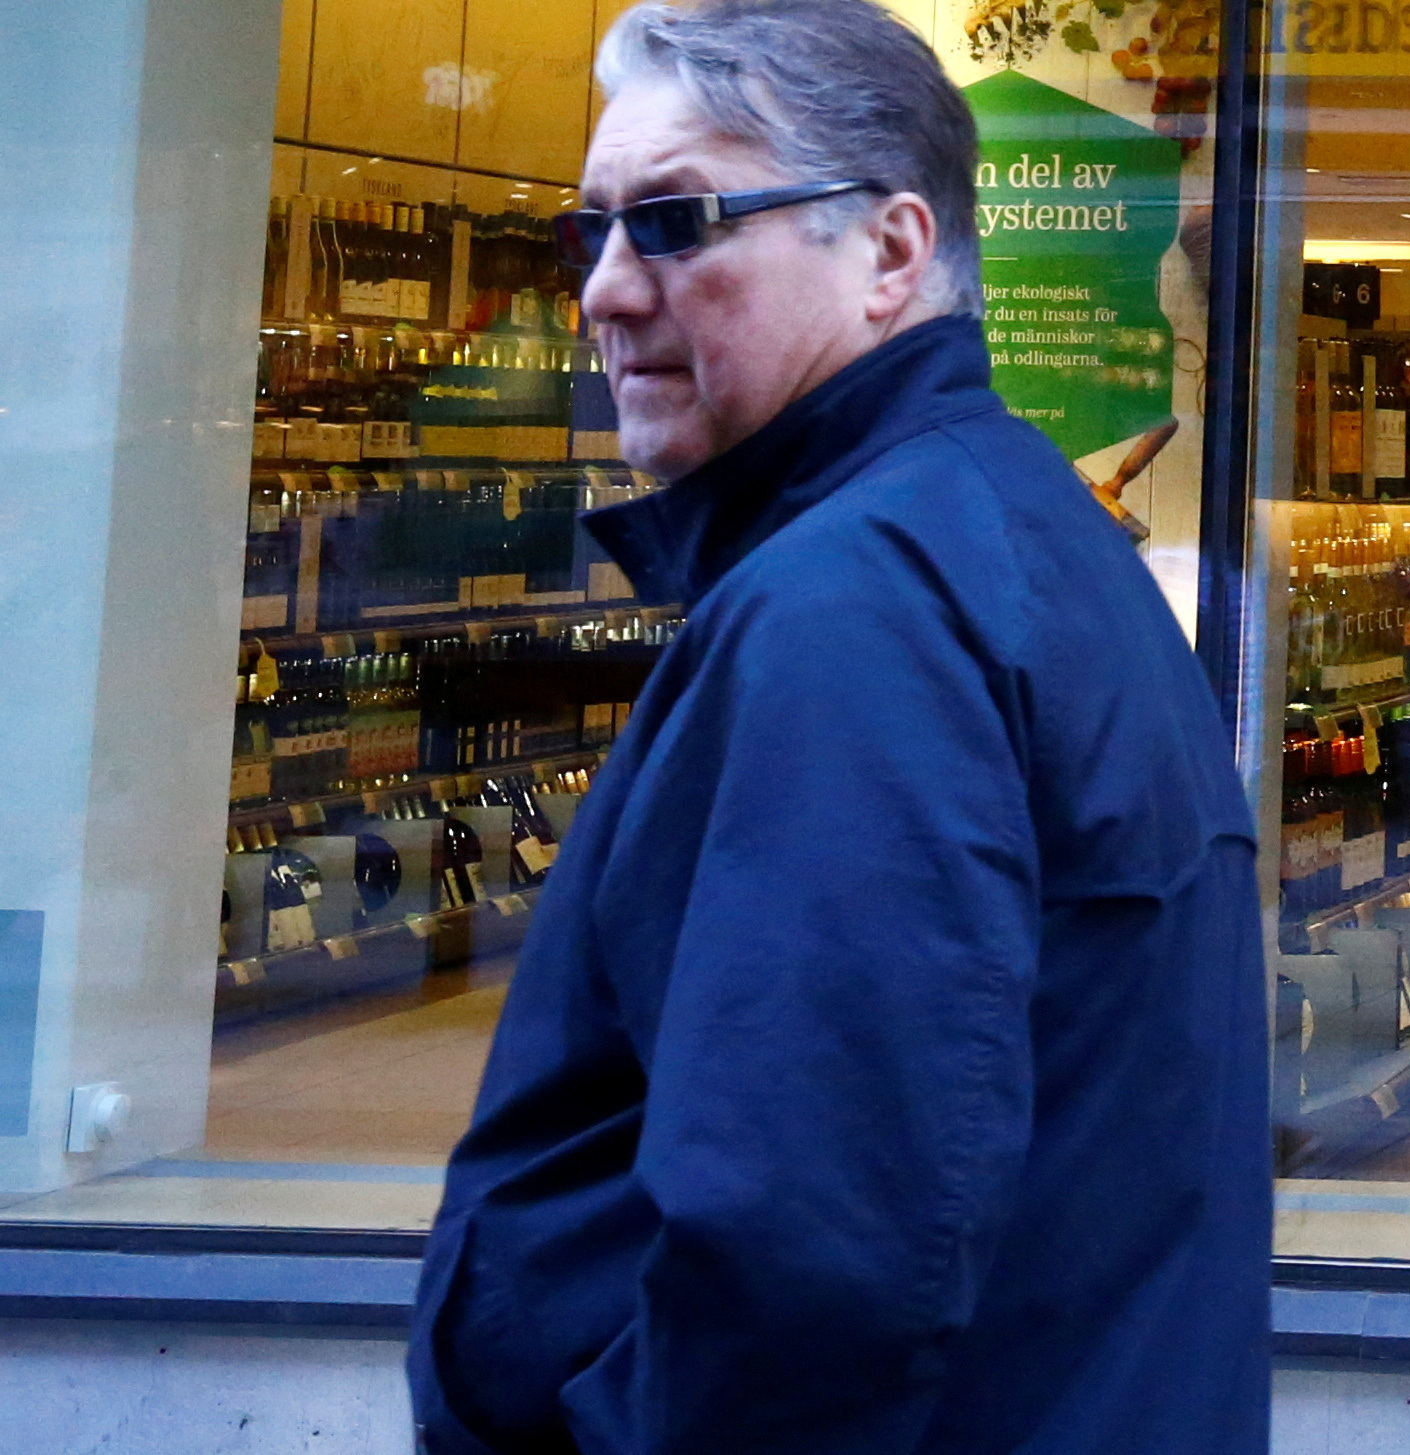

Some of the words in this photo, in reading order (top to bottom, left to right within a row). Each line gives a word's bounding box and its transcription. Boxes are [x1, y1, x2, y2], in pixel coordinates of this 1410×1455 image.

[974, 161, 998, 188] n
[1008, 153, 1062, 189] del
[1073, 163, 1117, 189] av
[974, 198, 1128, 237] ystemet
[982, 284, 1009, 302] ljer
[1012, 284, 1090, 302] ekologiskt
[1357, 283, 1371, 304] 6
[994, 306, 1015, 321] du
[1019, 310, 1037, 321] en
[1043, 307, 1089, 322] insats
[1011, 328, 1096, 344] människor
[990, 349, 1010, 367] på
[1014, 350, 1104, 368] odlingarna.
[1025, 408, 1049, 418] mer
